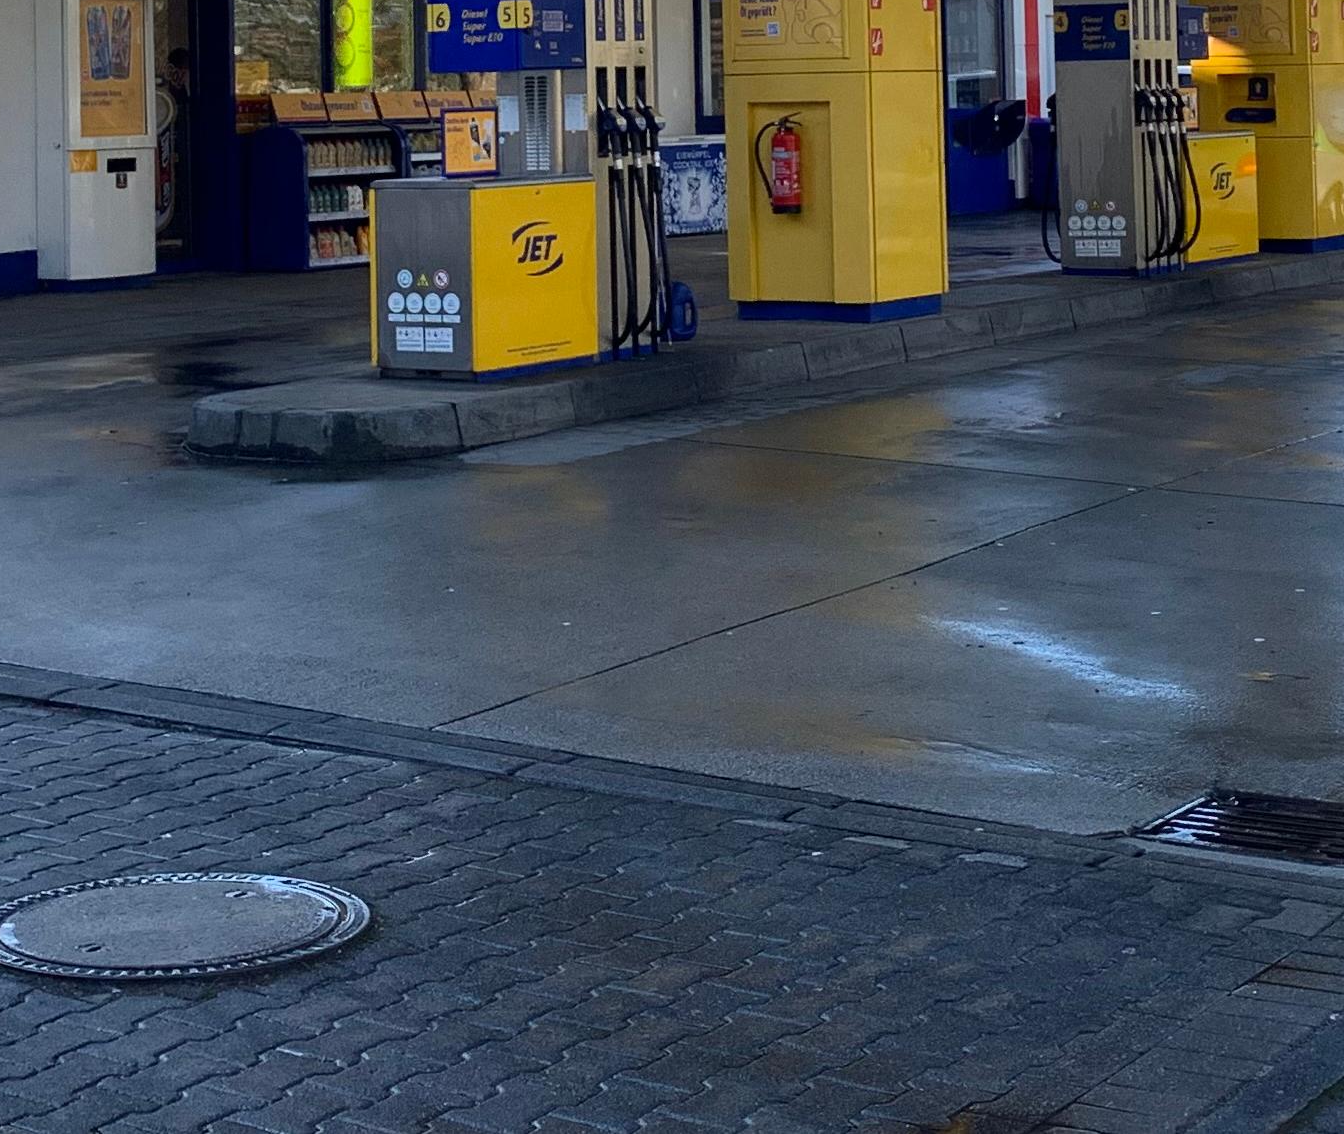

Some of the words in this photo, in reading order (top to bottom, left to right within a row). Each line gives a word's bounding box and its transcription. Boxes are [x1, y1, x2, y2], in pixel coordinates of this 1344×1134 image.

[435, 12, 445, 28] 6
[461, 8, 488, 19] Diesel
[503, 7, 511, 23] 5
[524, 7, 530, 24] 5
[1119, 14, 1126, 27] 3
[463, 22, 486, 34] Super
[463, 33, 486, 45] Super
[488, 32, 503, 42] E10
[1213, 172, 1232, 191] JET
[517, 234, 557, 264] JET
